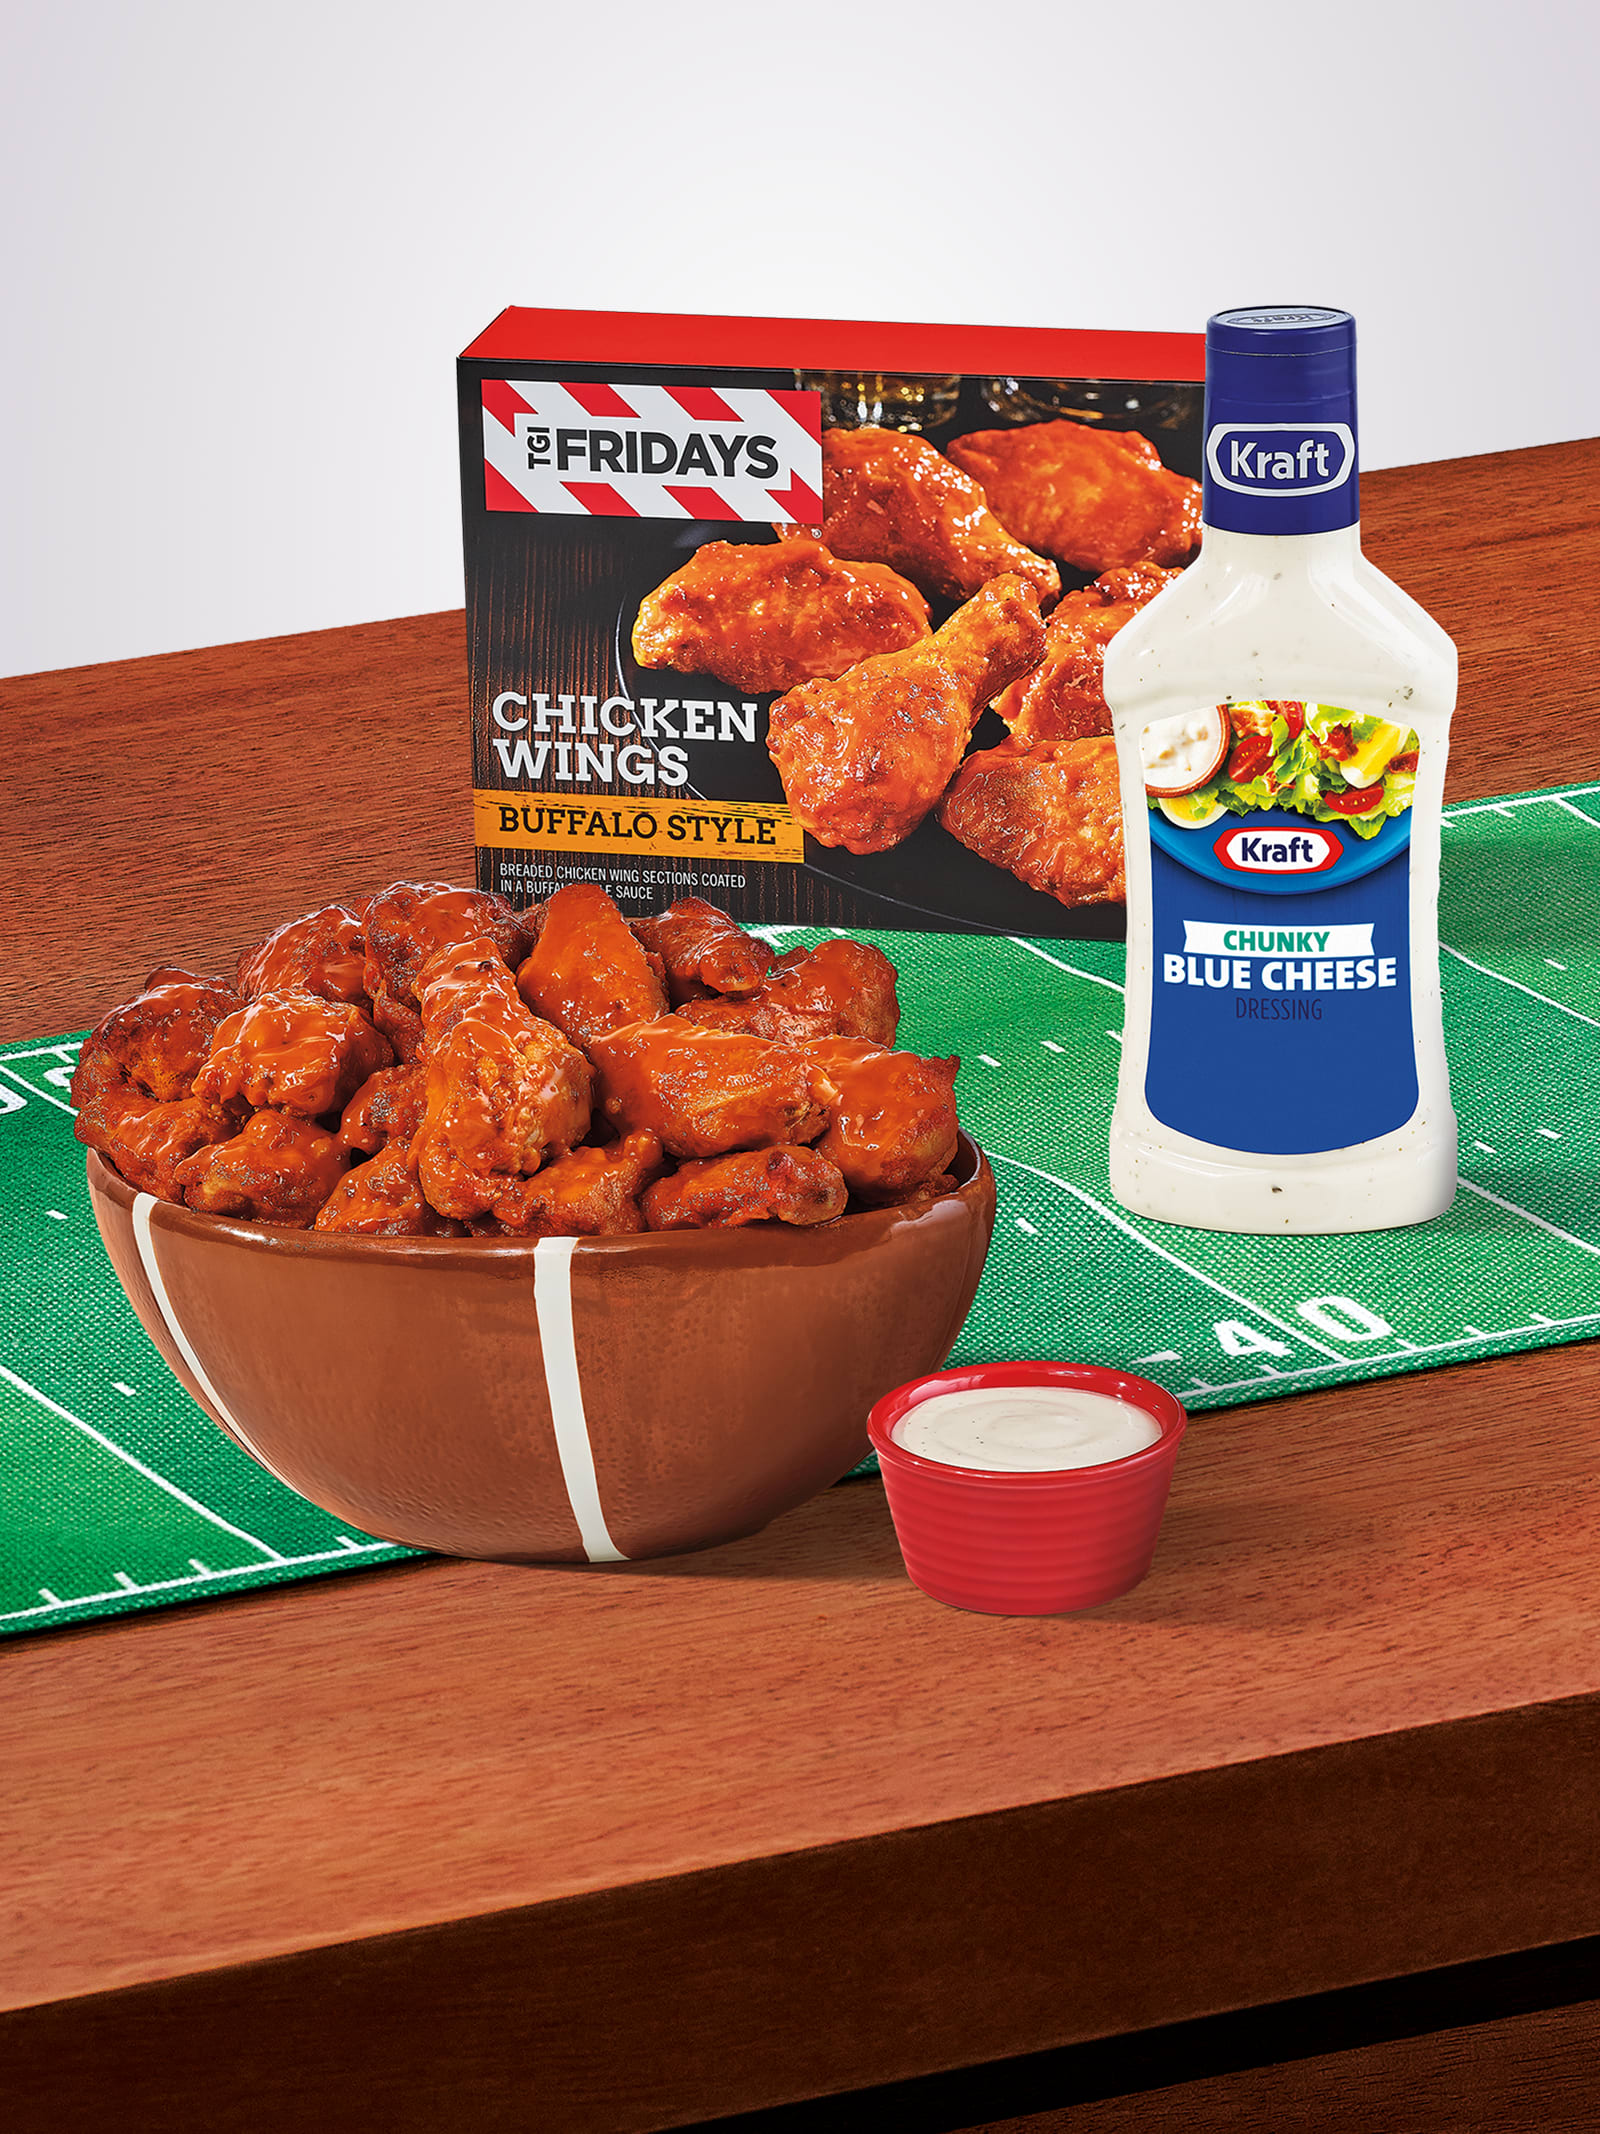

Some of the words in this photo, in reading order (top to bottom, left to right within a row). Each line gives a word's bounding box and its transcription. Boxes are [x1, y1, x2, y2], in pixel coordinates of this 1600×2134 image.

[526, 426, 551, 470] TGI
[556, 428, 779, 479] FRIDAYS
[1230, 439, 1330, 480] Kraft
[492, 691, 758, 743] CHICKEN
[493, 738, 689, 787] WINGS
[499, 807, 657, 839] BUFFALO
[667, 815, 777, 845] STYLE
[1241, 837, 1314, 863] Kraft
[500, 863, 552, 878] BREADED
[556, 865, 607, 881] CHICKEN
[609, 867, 639, 884] WING
[643, 870, 699, 886] SECTIONS
[701, 873, 746, 889] COATED
[500, 880, 512, 893] IN
[515, 880, 524, 893] A
[527, 881, 573, 895] BUFFA
[616, 885, 654, 900] SAUCE
[1223, 930, 1331, 953] CHUNKY
[1163, 953, 1252, 990] BLUE
[1261, 957, 1398, 991] CHEESE
[1235, 997, 1323, 1021] DRESSING
